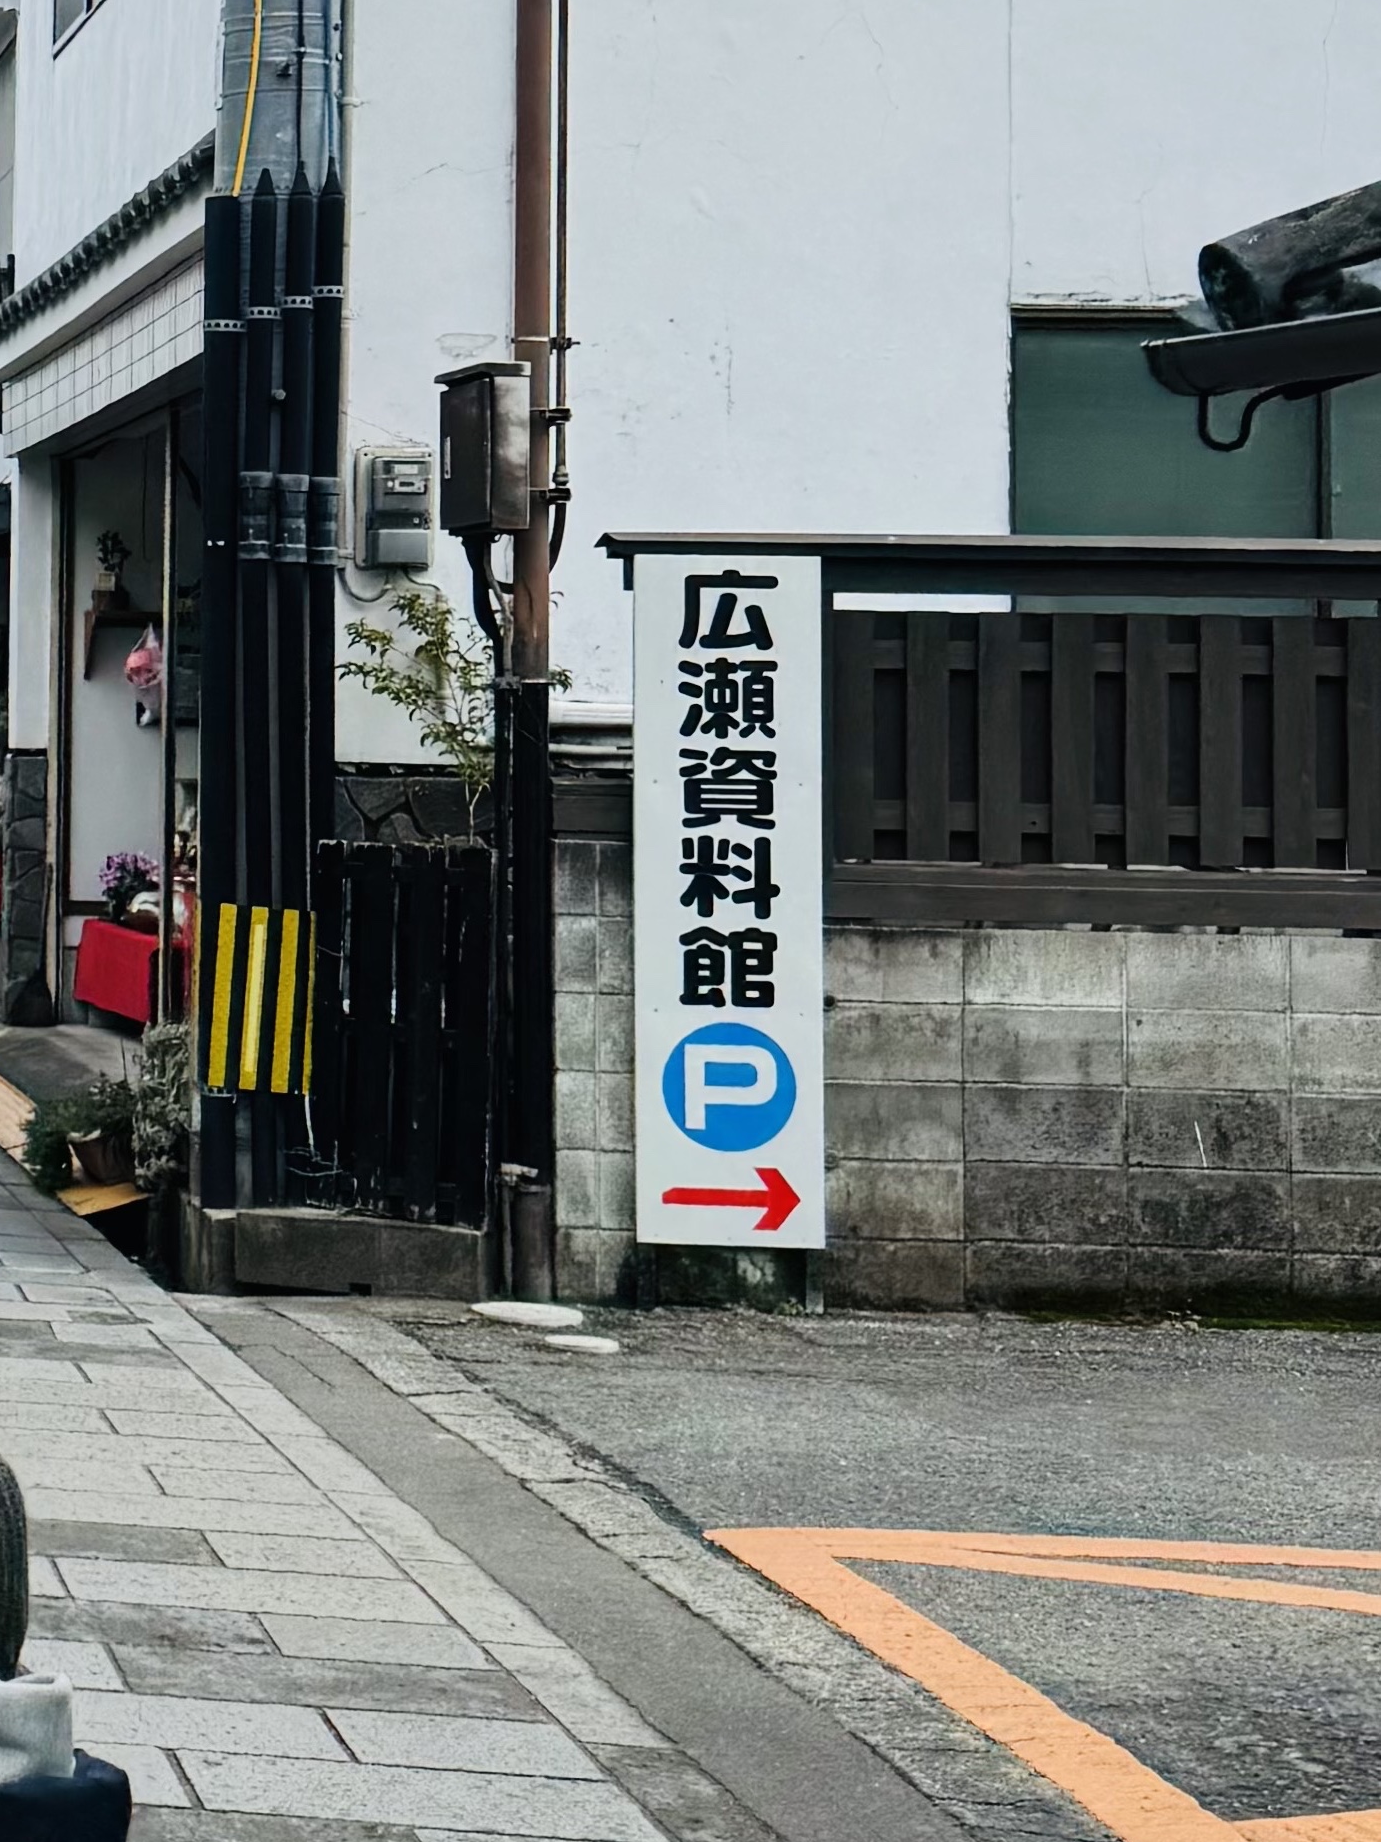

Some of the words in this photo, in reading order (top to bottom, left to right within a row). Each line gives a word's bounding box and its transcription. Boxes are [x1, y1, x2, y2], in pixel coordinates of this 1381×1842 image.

[676, 568, 781, 1010] 広瀬資料館
[684, 1043, 777, 1132] P
